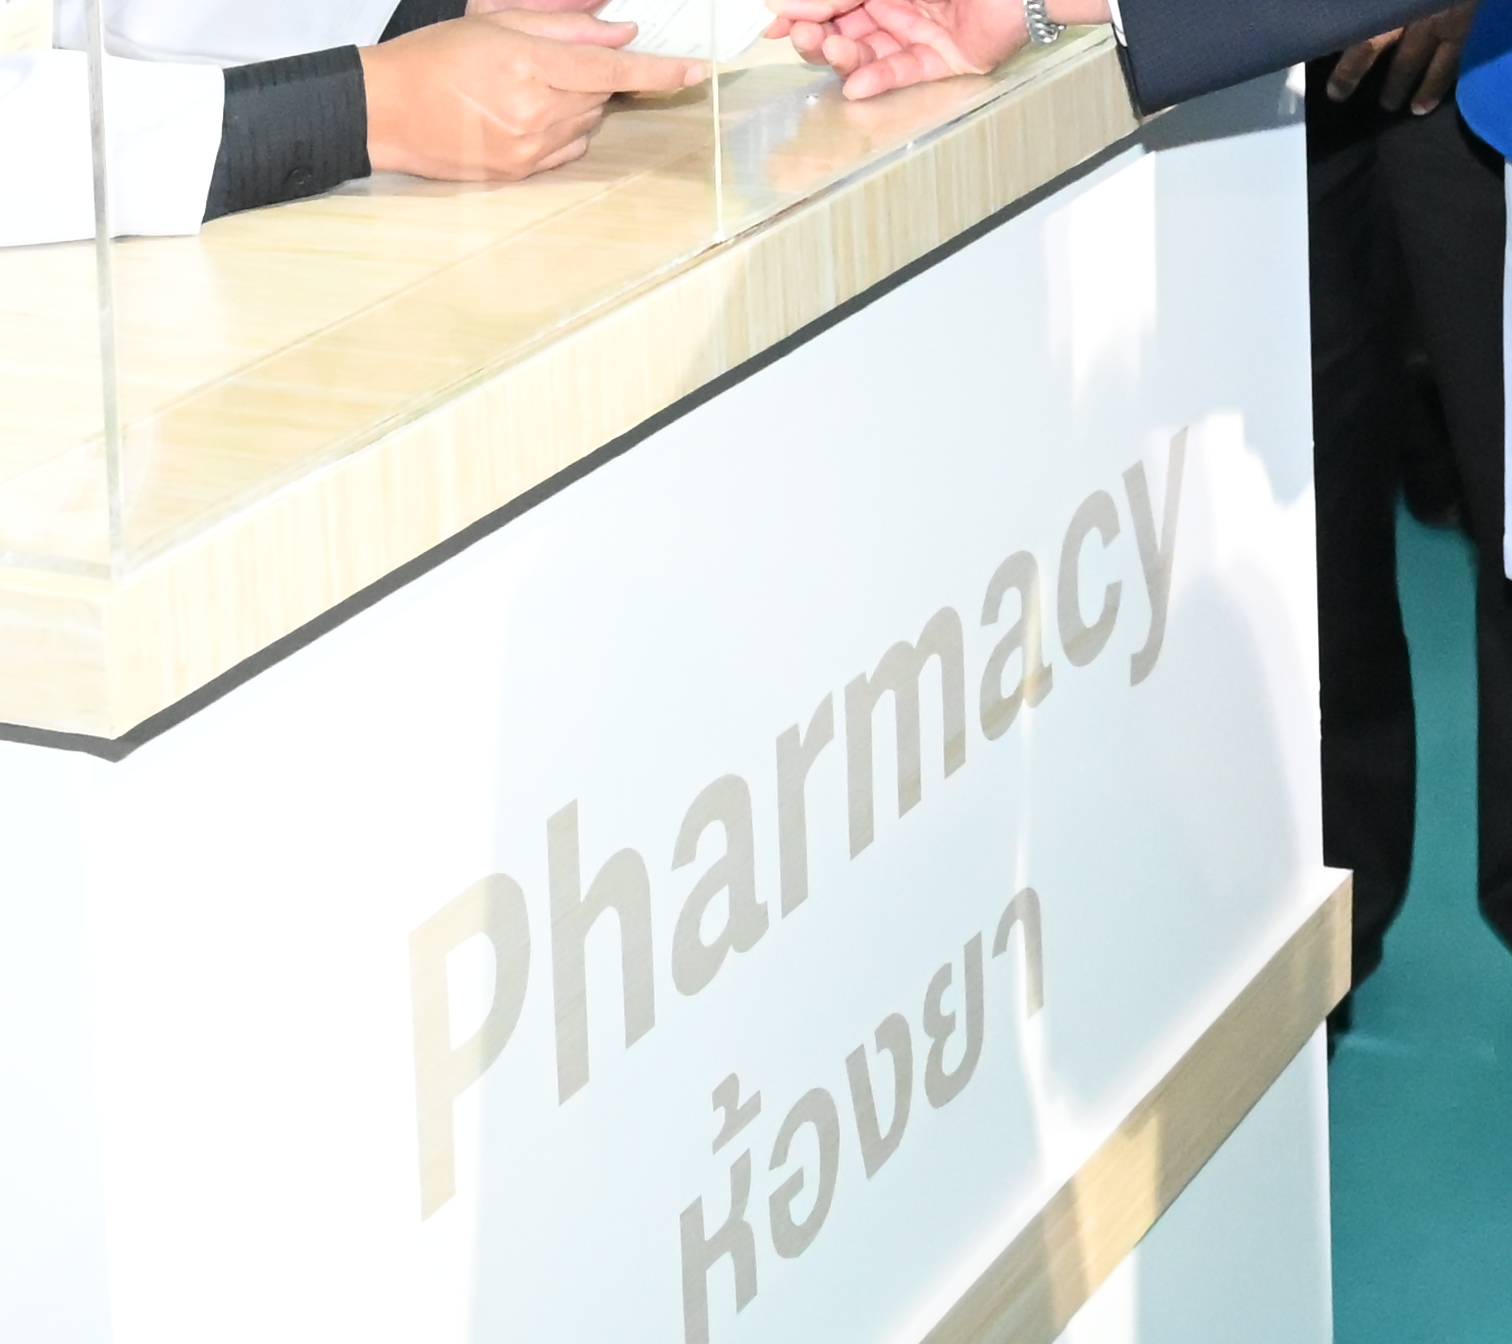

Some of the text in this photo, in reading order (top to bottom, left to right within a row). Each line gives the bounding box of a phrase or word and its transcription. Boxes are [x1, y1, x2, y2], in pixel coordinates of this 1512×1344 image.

[408, 424, 1188, 1224] Pharmacy
[678, 885, 1044, 1344] ห้องยา
